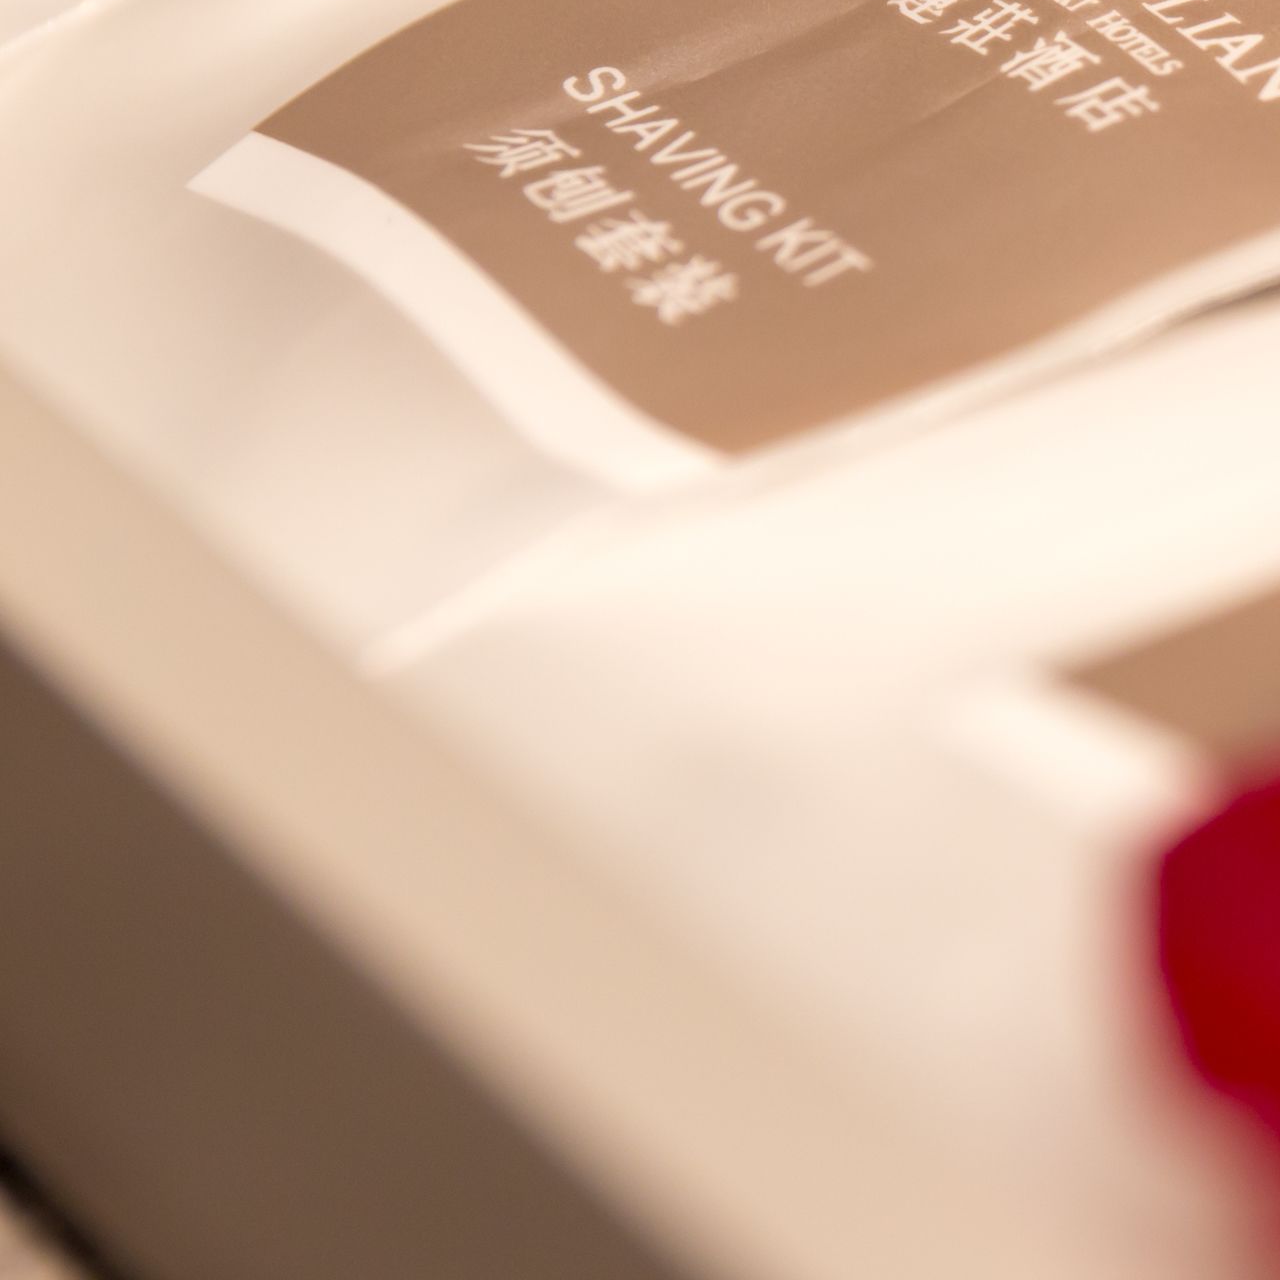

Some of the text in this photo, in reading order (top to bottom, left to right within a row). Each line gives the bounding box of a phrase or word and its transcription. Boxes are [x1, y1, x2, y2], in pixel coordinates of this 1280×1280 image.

[1085, 9, 1184, 77] HOTELS
[562, 65, 875, 289] SHAVING KIT
